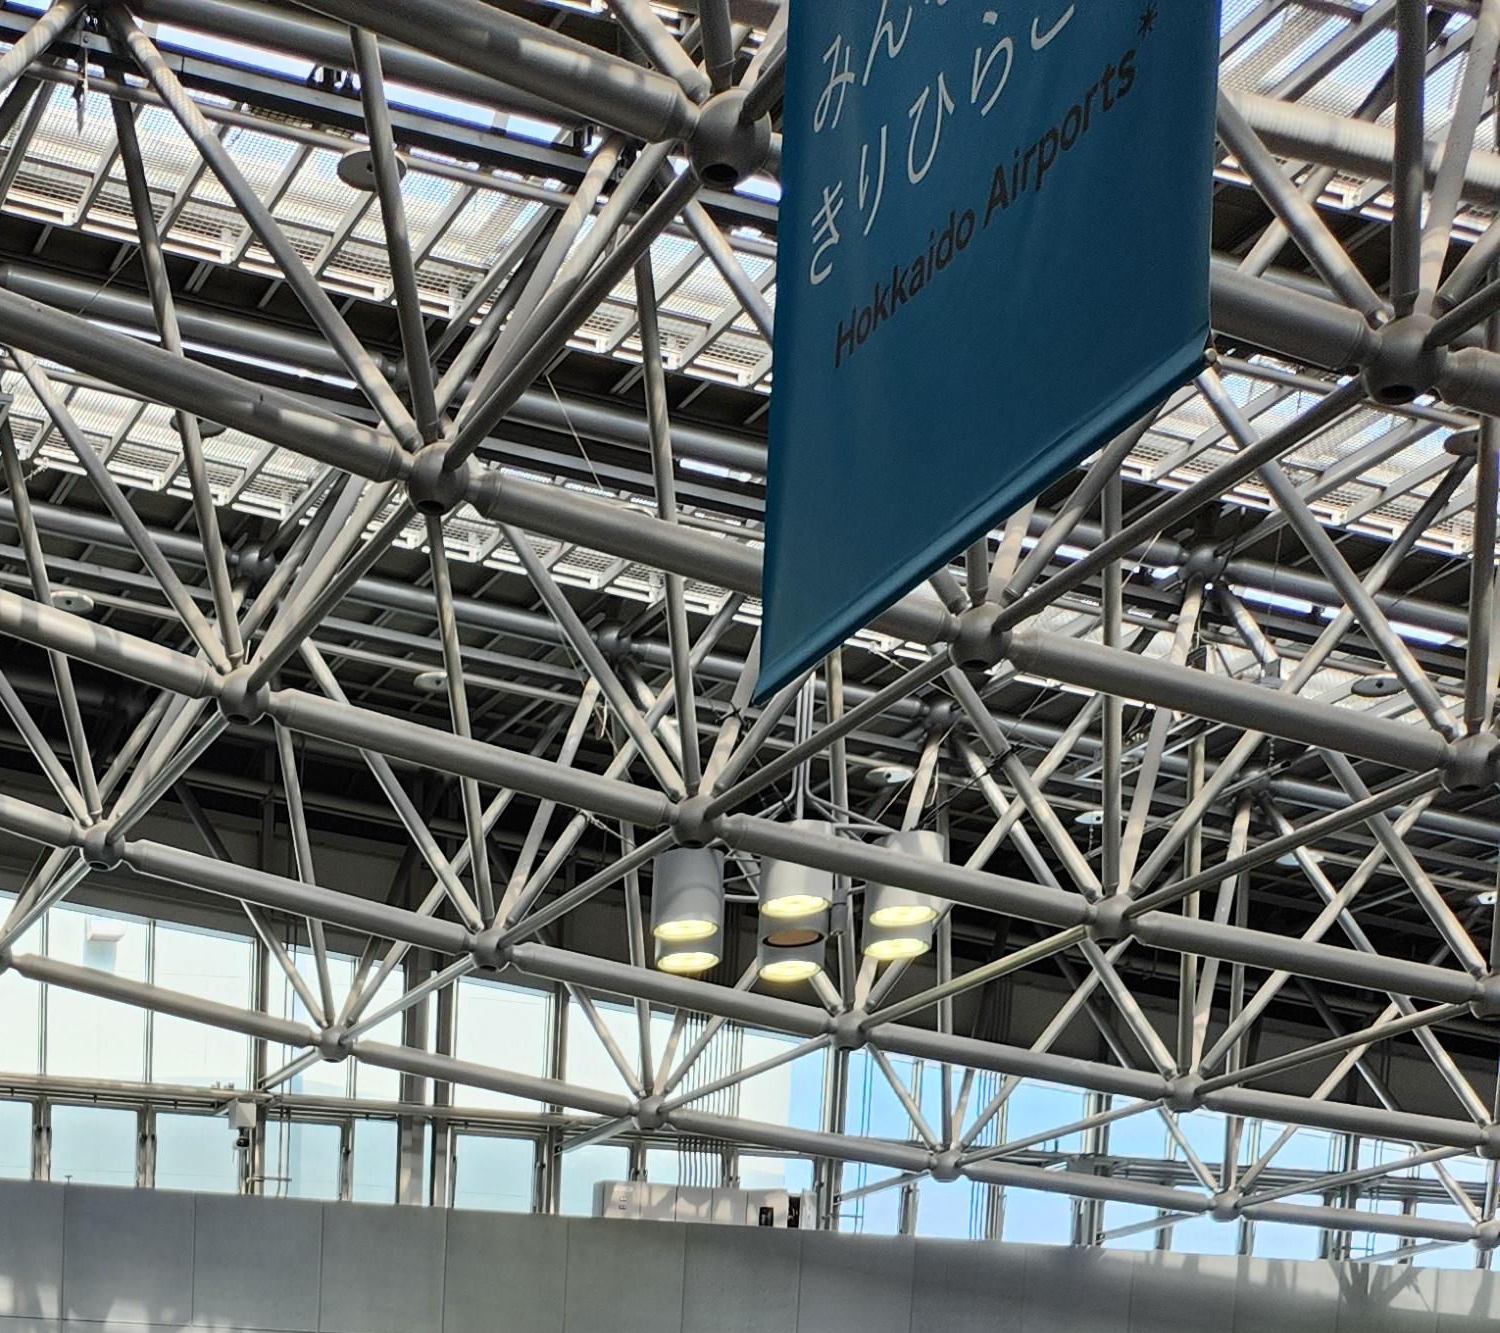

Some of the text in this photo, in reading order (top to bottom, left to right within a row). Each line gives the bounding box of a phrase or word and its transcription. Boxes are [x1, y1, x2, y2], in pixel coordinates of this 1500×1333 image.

[813, 0, 948, 133] みん
[833, 48, 1137, 368] Hokkaido Airports
